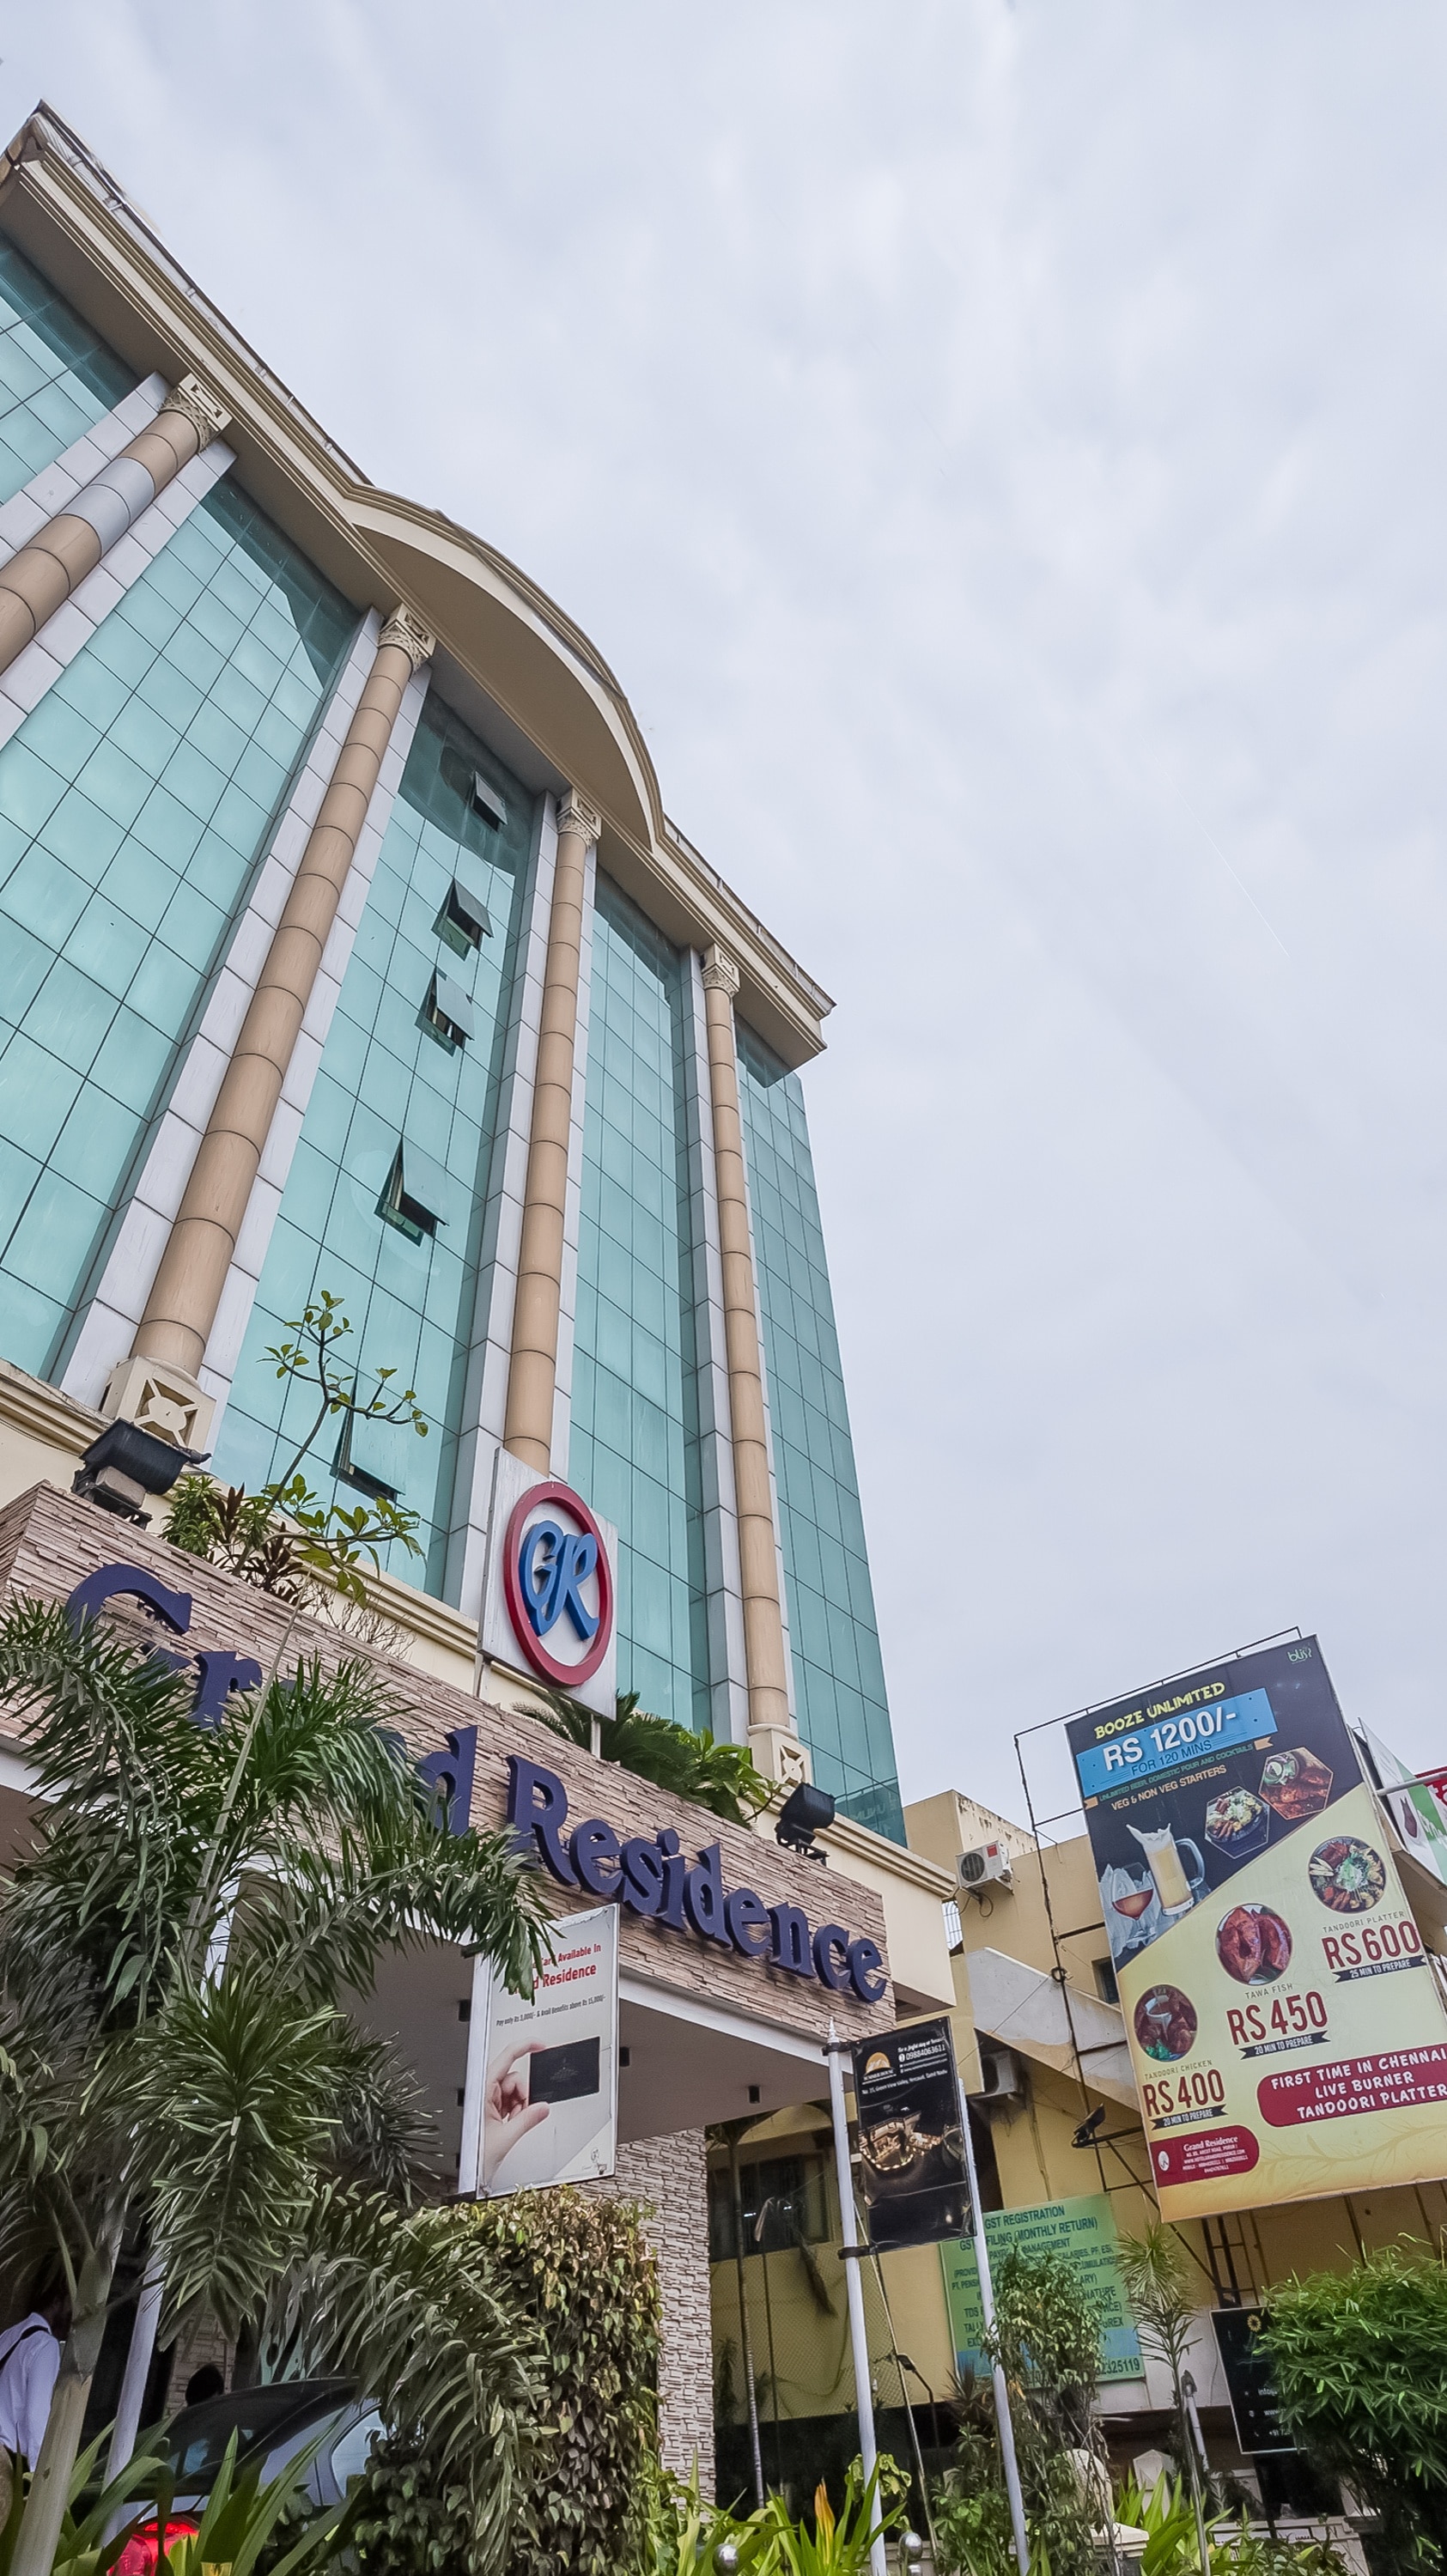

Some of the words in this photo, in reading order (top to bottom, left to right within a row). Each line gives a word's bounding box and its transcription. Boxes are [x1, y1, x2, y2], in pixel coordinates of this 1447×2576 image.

[519, 1520, 599, 1641] GR
[1094, 1710, 1145, 1740] BOOZE
[1146, 1681, 1225, 1718] UNLIMITED
[1103, 1737, 1143, 1771] RS
[1151, 1706, 1237, 1752] 1200/-
[1099, 1785, 1130, 1801] UNLIMITED
[1148, 1767, 1181, 1783] DOMESTIC
[1201, 1756, 1215, 1765] AND
[1215, 1743, 1254, 1760] COCKTAILS
[1131, 1759, 1157, 1776] FOR
[1159, 1752, 1179, 1765] 120
[1181, 1740, 1212, 1759] MINS
[1111, 1798, 1130, 1811] VEG
[1130, 1795, 1137, 1804] &
[1137, 1787, 1158, 1801] NON
[1158, 1781, 1178, 1794] VEG
[1179, 1764, 1227, 1787] STARTERS
[507, 1754, 886, 2002] Residence
[1322, 1918, 1364, 1933] TANDOORI
[1366, 1911, 1405, 1925] PLATTER
[558, 1947, 592, 1962] Available
[593, 1943, 601, 1953] In
[1321, 1932, 1362, 1970] RS
[1361, 1920, 1420, 1961] 600
[543, 1965, 597, 1988] Residence
[1373, 1964, 1383, 1974] TO
[1383, 1959, 1411, 1972] PREPARE
[1245, 1988, 1269, 2000] TAWA
[1272, 1983, 1293, 1994] FISH
[1226, 2004, 1267, 2045] RS
[1271, 1991, 1328, 2035] 450
[1264, 2043, 1278, 2053] MIN
[1277, 2040, 1286, 2050] TO
[1286, 2035, 1313, 2048] PREPARE
[1144, 2067, 1178, 2081] TANDOORI
[1181, 2060, 1213, 2072] CHICKEN
[1270, 2071, 1311, 2090] FIRST
[1316, 2064, 1352, 2081] TIME
[1357, 2060, 1372, 2074] IN
[1378, 2047, 1447, 2070] CHENNAI
[1315, 2081, 1347, 2099] LIVE
[1351, 2070, 1414, 2092] BURNER
[1142, 2081, 1174, 2117] RS
[1178, 2069, 1225, 2108] 400
[1297, 2094, 1376, 2119] TANDOORI
[1379, 2083, 1447, 2104] PLATTER
[1189, 2108, 1213, 2121] PREPARE
[1183, 2141, 1205, 2152] Grand
[1205, 2136, 1238, 2148] Residence
[984, 2216, 1001, 2229] GST
[1003, 2205, 1065, 2226] REGISTRATION
[986, 2233, 1012, 2246] FILING
[1059, 2216, 1098, 2233] RETURN)
